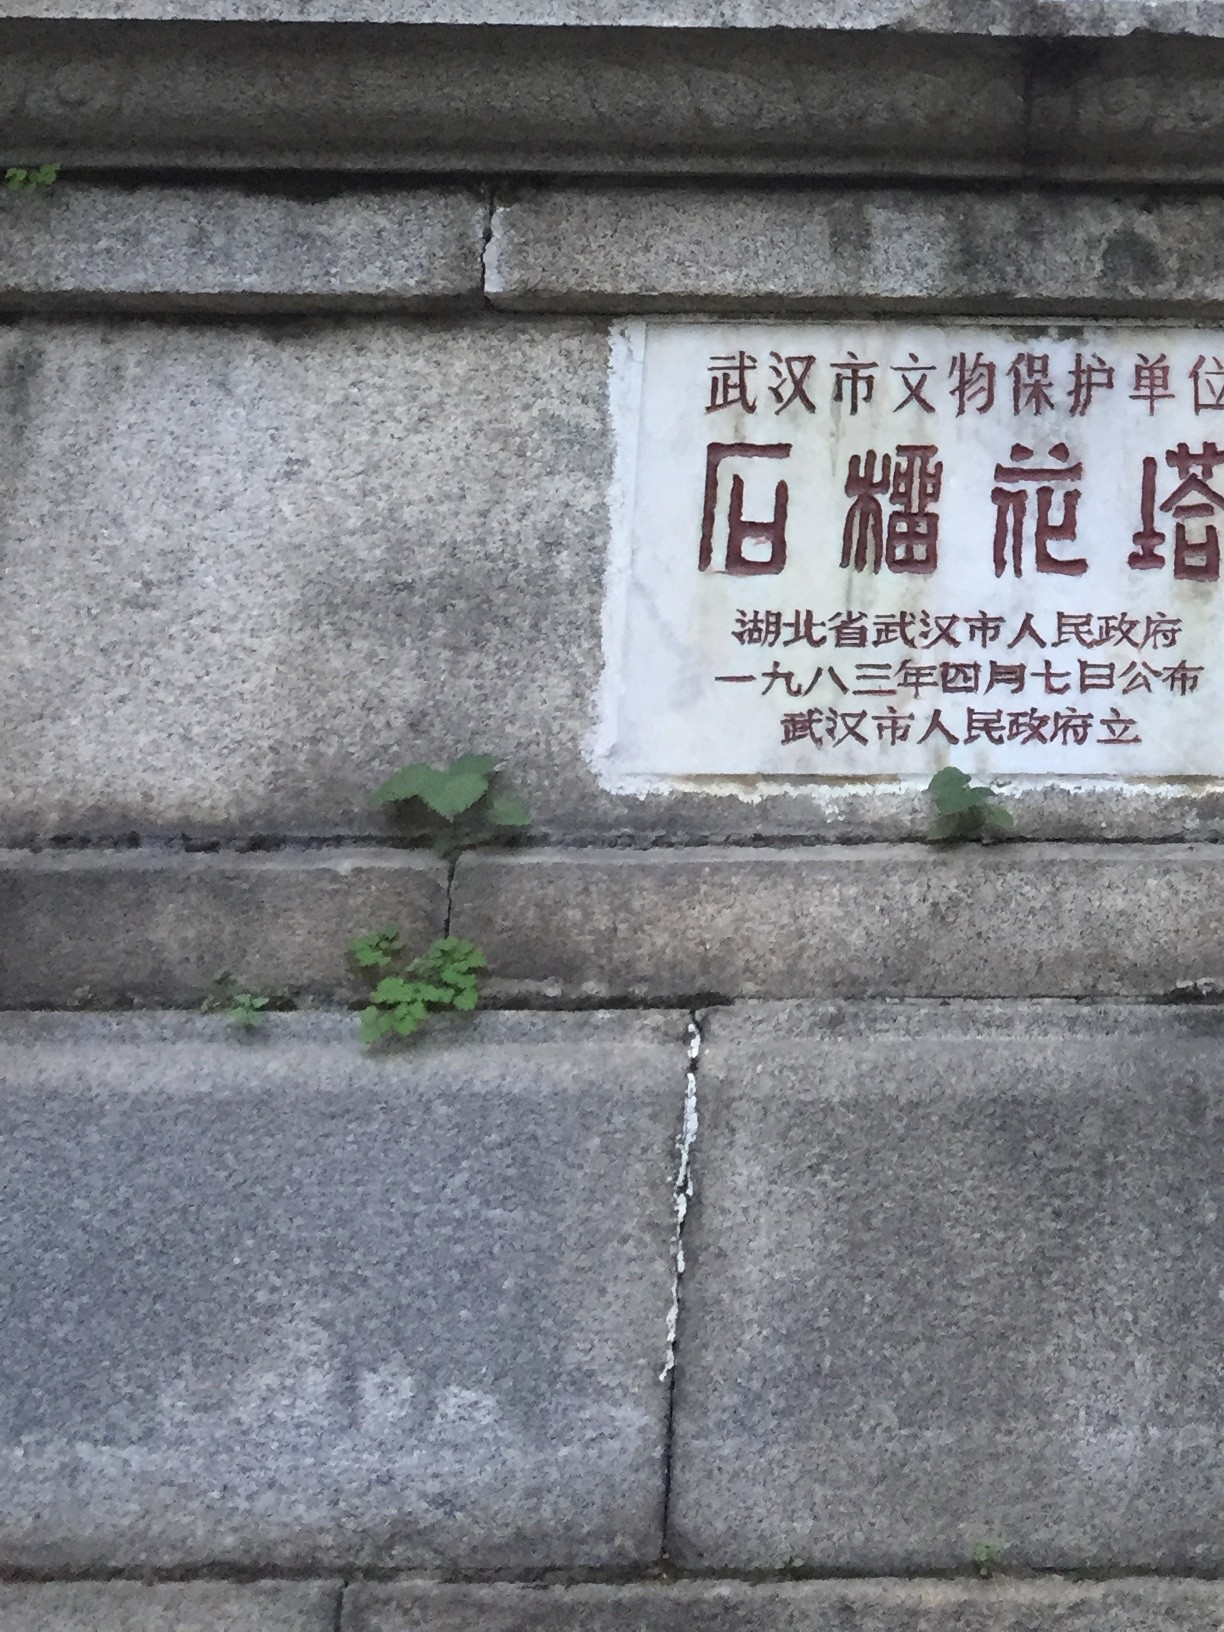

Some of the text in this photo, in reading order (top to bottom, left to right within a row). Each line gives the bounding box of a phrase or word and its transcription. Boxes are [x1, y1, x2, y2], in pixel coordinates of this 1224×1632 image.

[730, 608, 1184, 652] 湖北省武汉市人民政府
[714, 661, 1206, 699] 一九八三年四月七日公布
[779, 707, 1143, 749] 武汉市人民政府立
